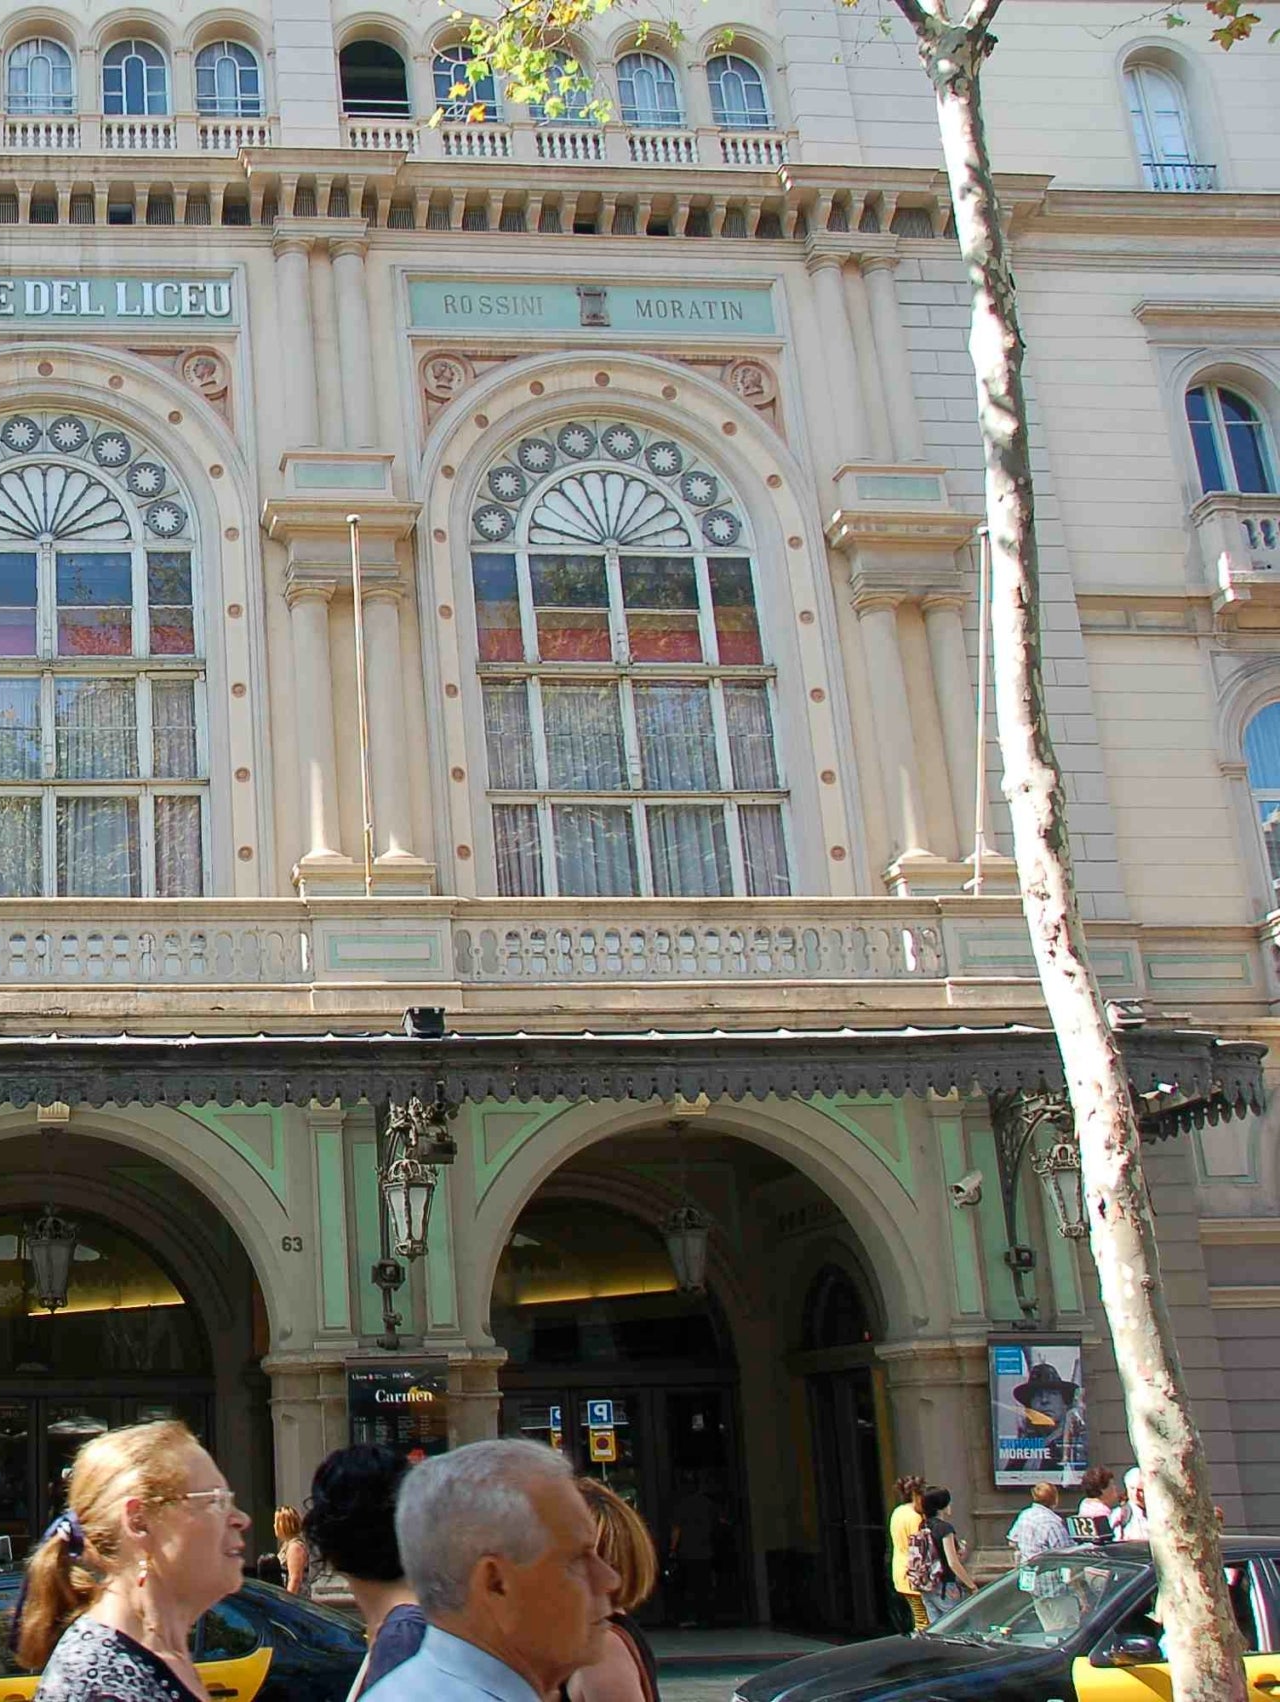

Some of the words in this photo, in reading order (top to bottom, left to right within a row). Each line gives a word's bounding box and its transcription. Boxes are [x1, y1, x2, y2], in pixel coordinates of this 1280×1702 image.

[23, 280, 105, 317] DEL
[116, 281, 232, 318] LICEU
[443, 294, 544, 316] ROSSINI
[635, 298, 744, 321] MORATIN
[282, 1236, 303, 1252] 63
[375, 1389, 433, 1403] Carmen
[999, 1448, 1052, 1460] MORENTE
[1073, 1517, 1098, 1536] 123
